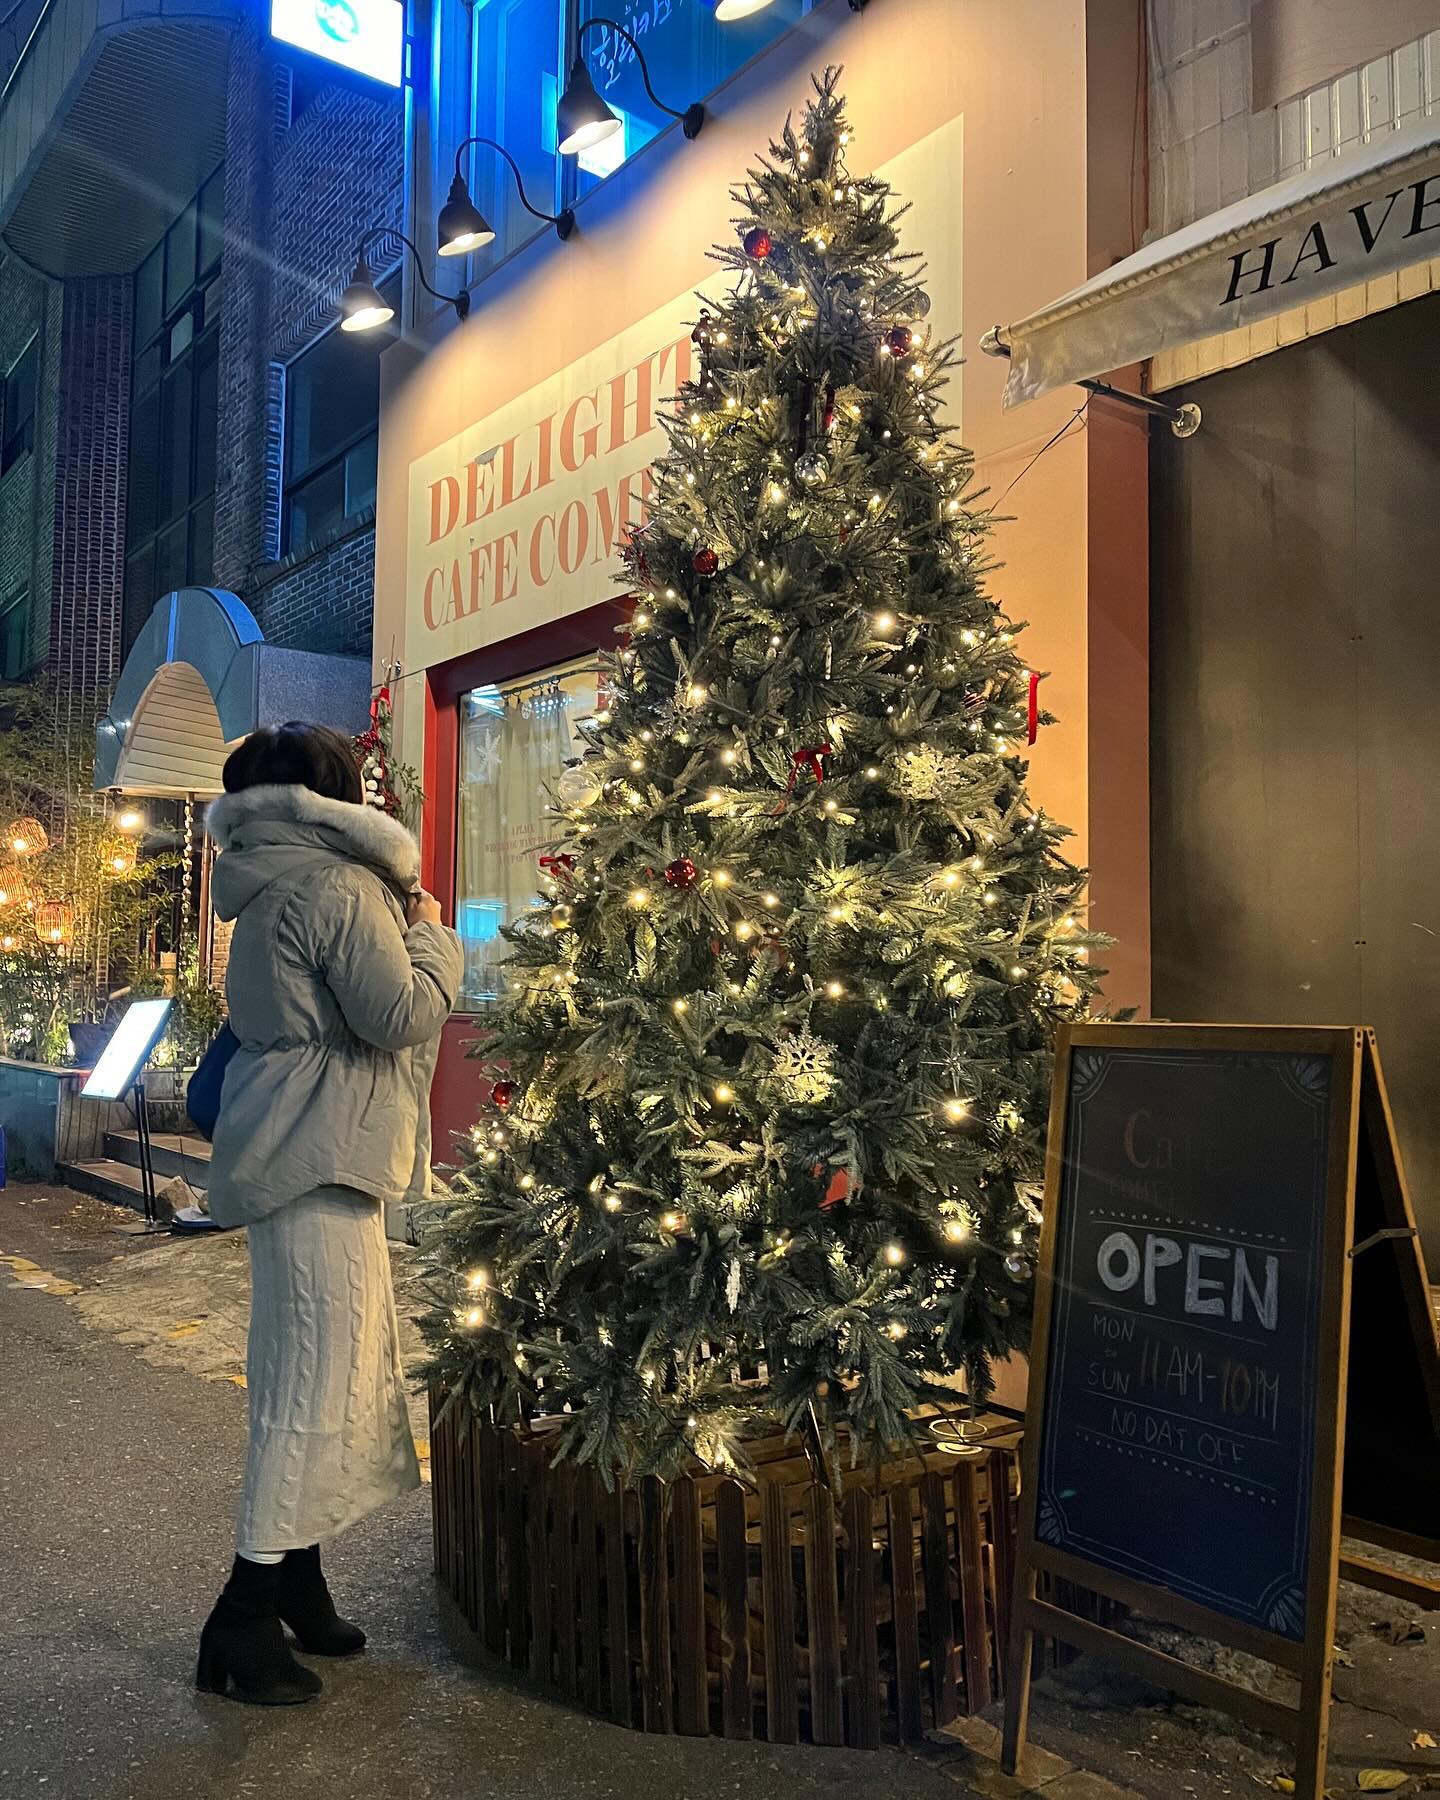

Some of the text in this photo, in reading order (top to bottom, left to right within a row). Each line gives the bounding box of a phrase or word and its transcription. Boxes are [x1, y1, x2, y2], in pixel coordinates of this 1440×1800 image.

[427, 334, 692, 546] DELIGHT
[423, 530, 519, 631] CAFE
[1096, 1231, 1280, 1331] OPEN
[1093, 1313, 1136, 1343] MON
[1087, 1361, 1131, 1395] SUN
[1110, 1406, 1138, 1437] NO
